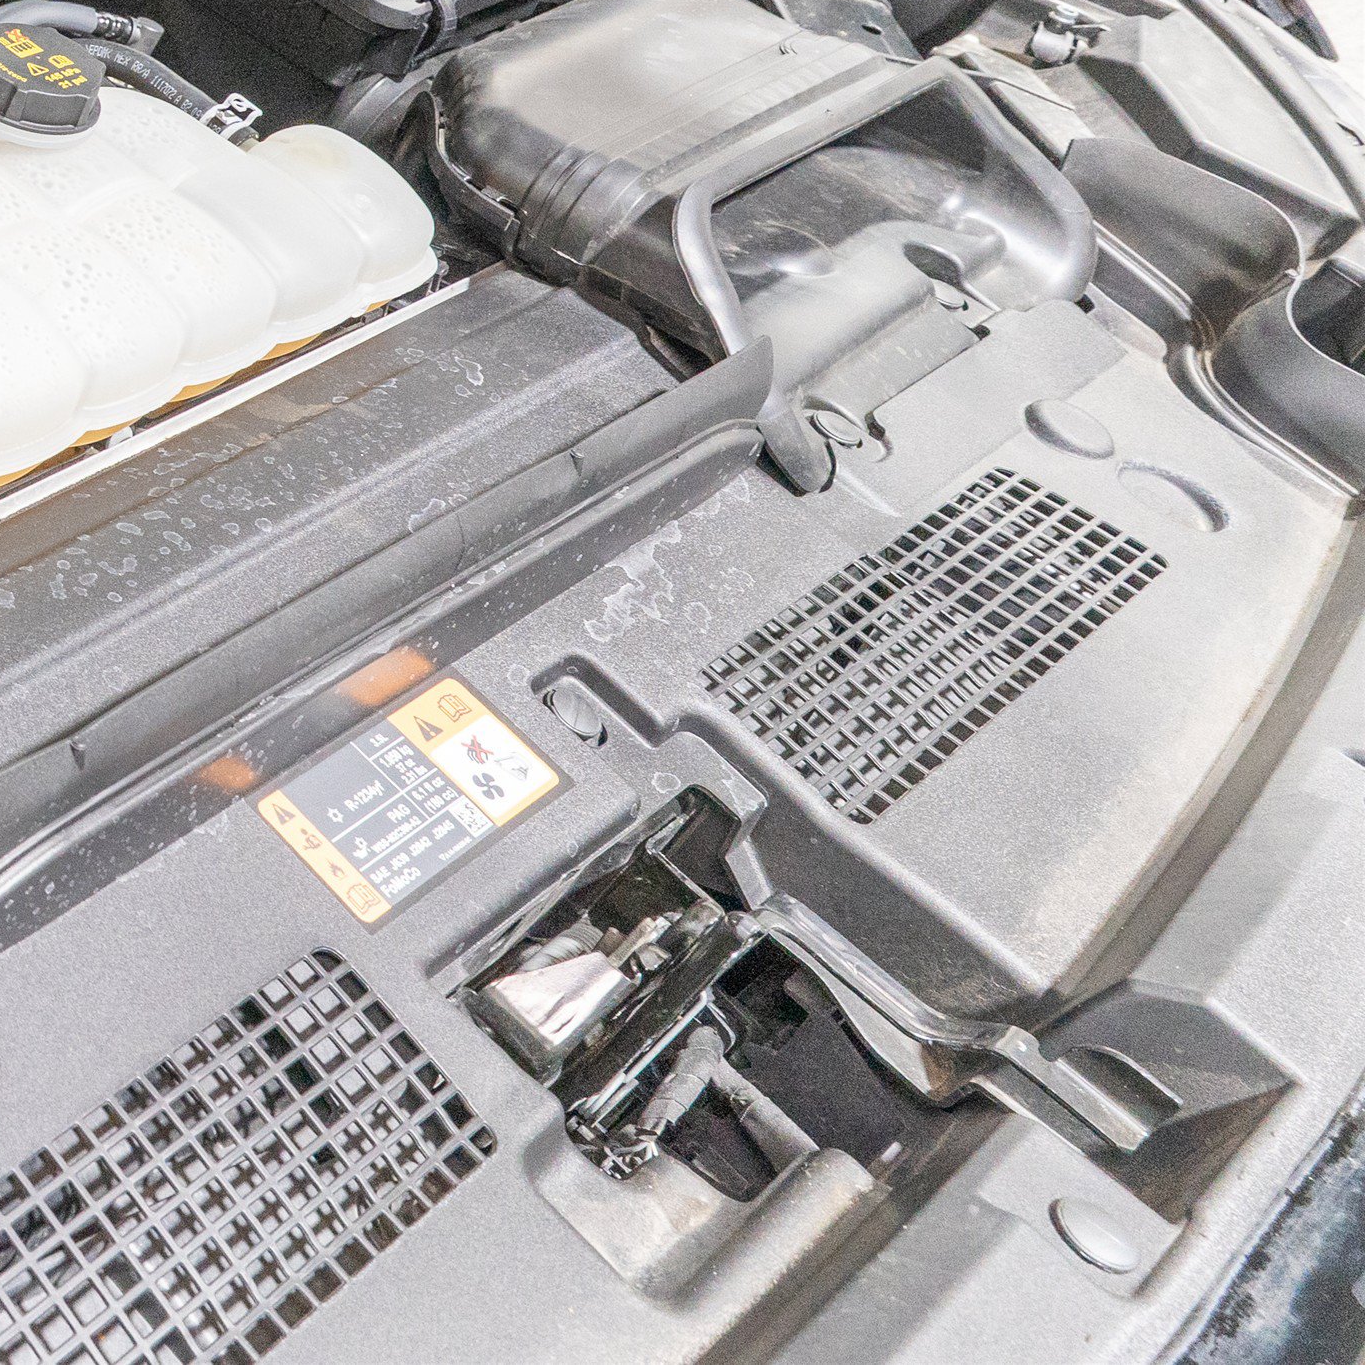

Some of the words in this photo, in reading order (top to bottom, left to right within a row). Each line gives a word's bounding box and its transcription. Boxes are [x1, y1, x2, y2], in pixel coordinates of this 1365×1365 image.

[113, 50, 130, 70] MEX
[344, 780, 386, 812] R-1234yf
[387, 804, 410, 822] PAG
[370, 866, 390, 883] SAE
[380, 865, 421, 897] FoMoCo
